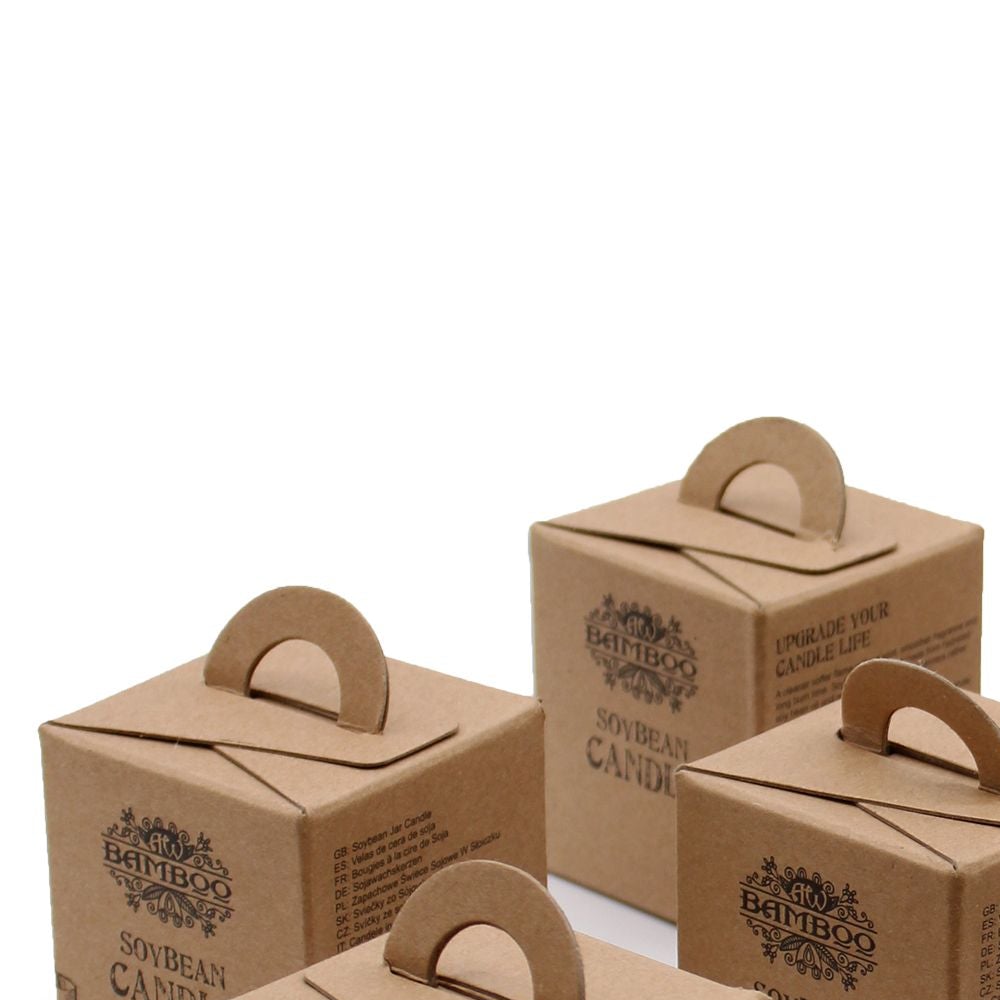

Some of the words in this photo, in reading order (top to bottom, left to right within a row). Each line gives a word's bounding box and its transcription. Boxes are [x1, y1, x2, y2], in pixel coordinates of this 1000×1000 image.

[586, 624, 697, 682] BAMBOO
[776, 615, 845, 655] UPGRADE
[850, 600, 888, 629] YOUR
[776, 641, 833, 679] CANDLE
[839, 628, 870, 656] LIFE
[596, 708, 688, 760] SOYBEAN
[586, 736, 676, 798] CANDL
[334, 847, 348, 860] GB:
[352, 830, 387, 852] Soybean
[390, 824, 402, 835] Jar
[404, 810, 431, 829] Candle
[335, 860, 348, 873] ES:
[352, 850, 373, 866] Velas
[376, 844, 385, 855] de
[388, 836, 405, 849] cera
[409, 830, 417, 840] de
[421, 822, 435, 835] soja
[335, 873, 348, 886] FR:
[352, 858, 384, 879] Bougies
[395, 851, 401, 860] la
[403, 844, 417, 856] cire
[420, 838, 429, 848] de
[431, 830, 448, 843] Soja
[102, 840, 233, 903] BAMBOO
[335, 887, 349, 900] DE:
[352, 855, 422, 892] Sojawachskerzen
[352, 878, 400, 906] Zapachowe
[431, 851, 458, 870] Sojowe
[460, 844, 468, 856] W
[740, 889, 876, 956] BAMBOO
[120, 931, 226, 990] SOYBEAN
